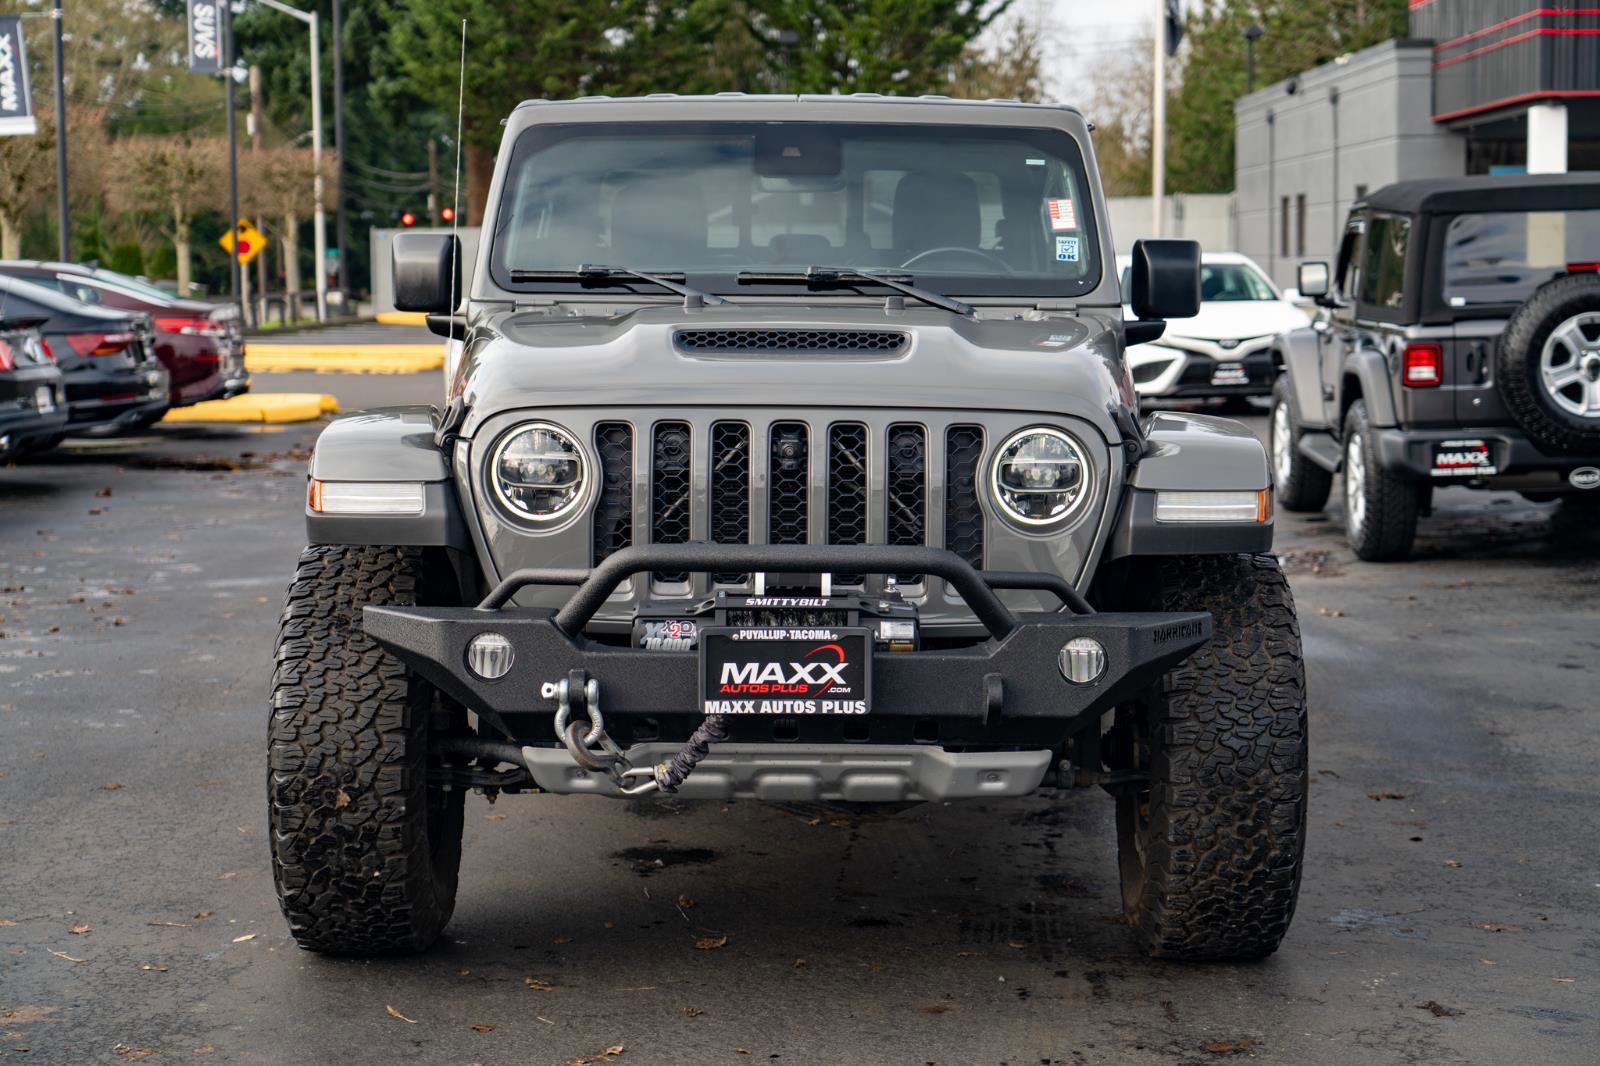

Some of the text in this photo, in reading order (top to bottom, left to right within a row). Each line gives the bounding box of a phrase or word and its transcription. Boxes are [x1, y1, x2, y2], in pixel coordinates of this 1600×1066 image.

[1436, 451, 1489, 465] MAXX
[745, 598, 830, 607] SMITTYBILT
[720, 662, 849, 685] MAXX
[720, 684, 809, 693] AUTOS PLUS
[704, 701, 866, 714] MAXX AUTOS PLUS
